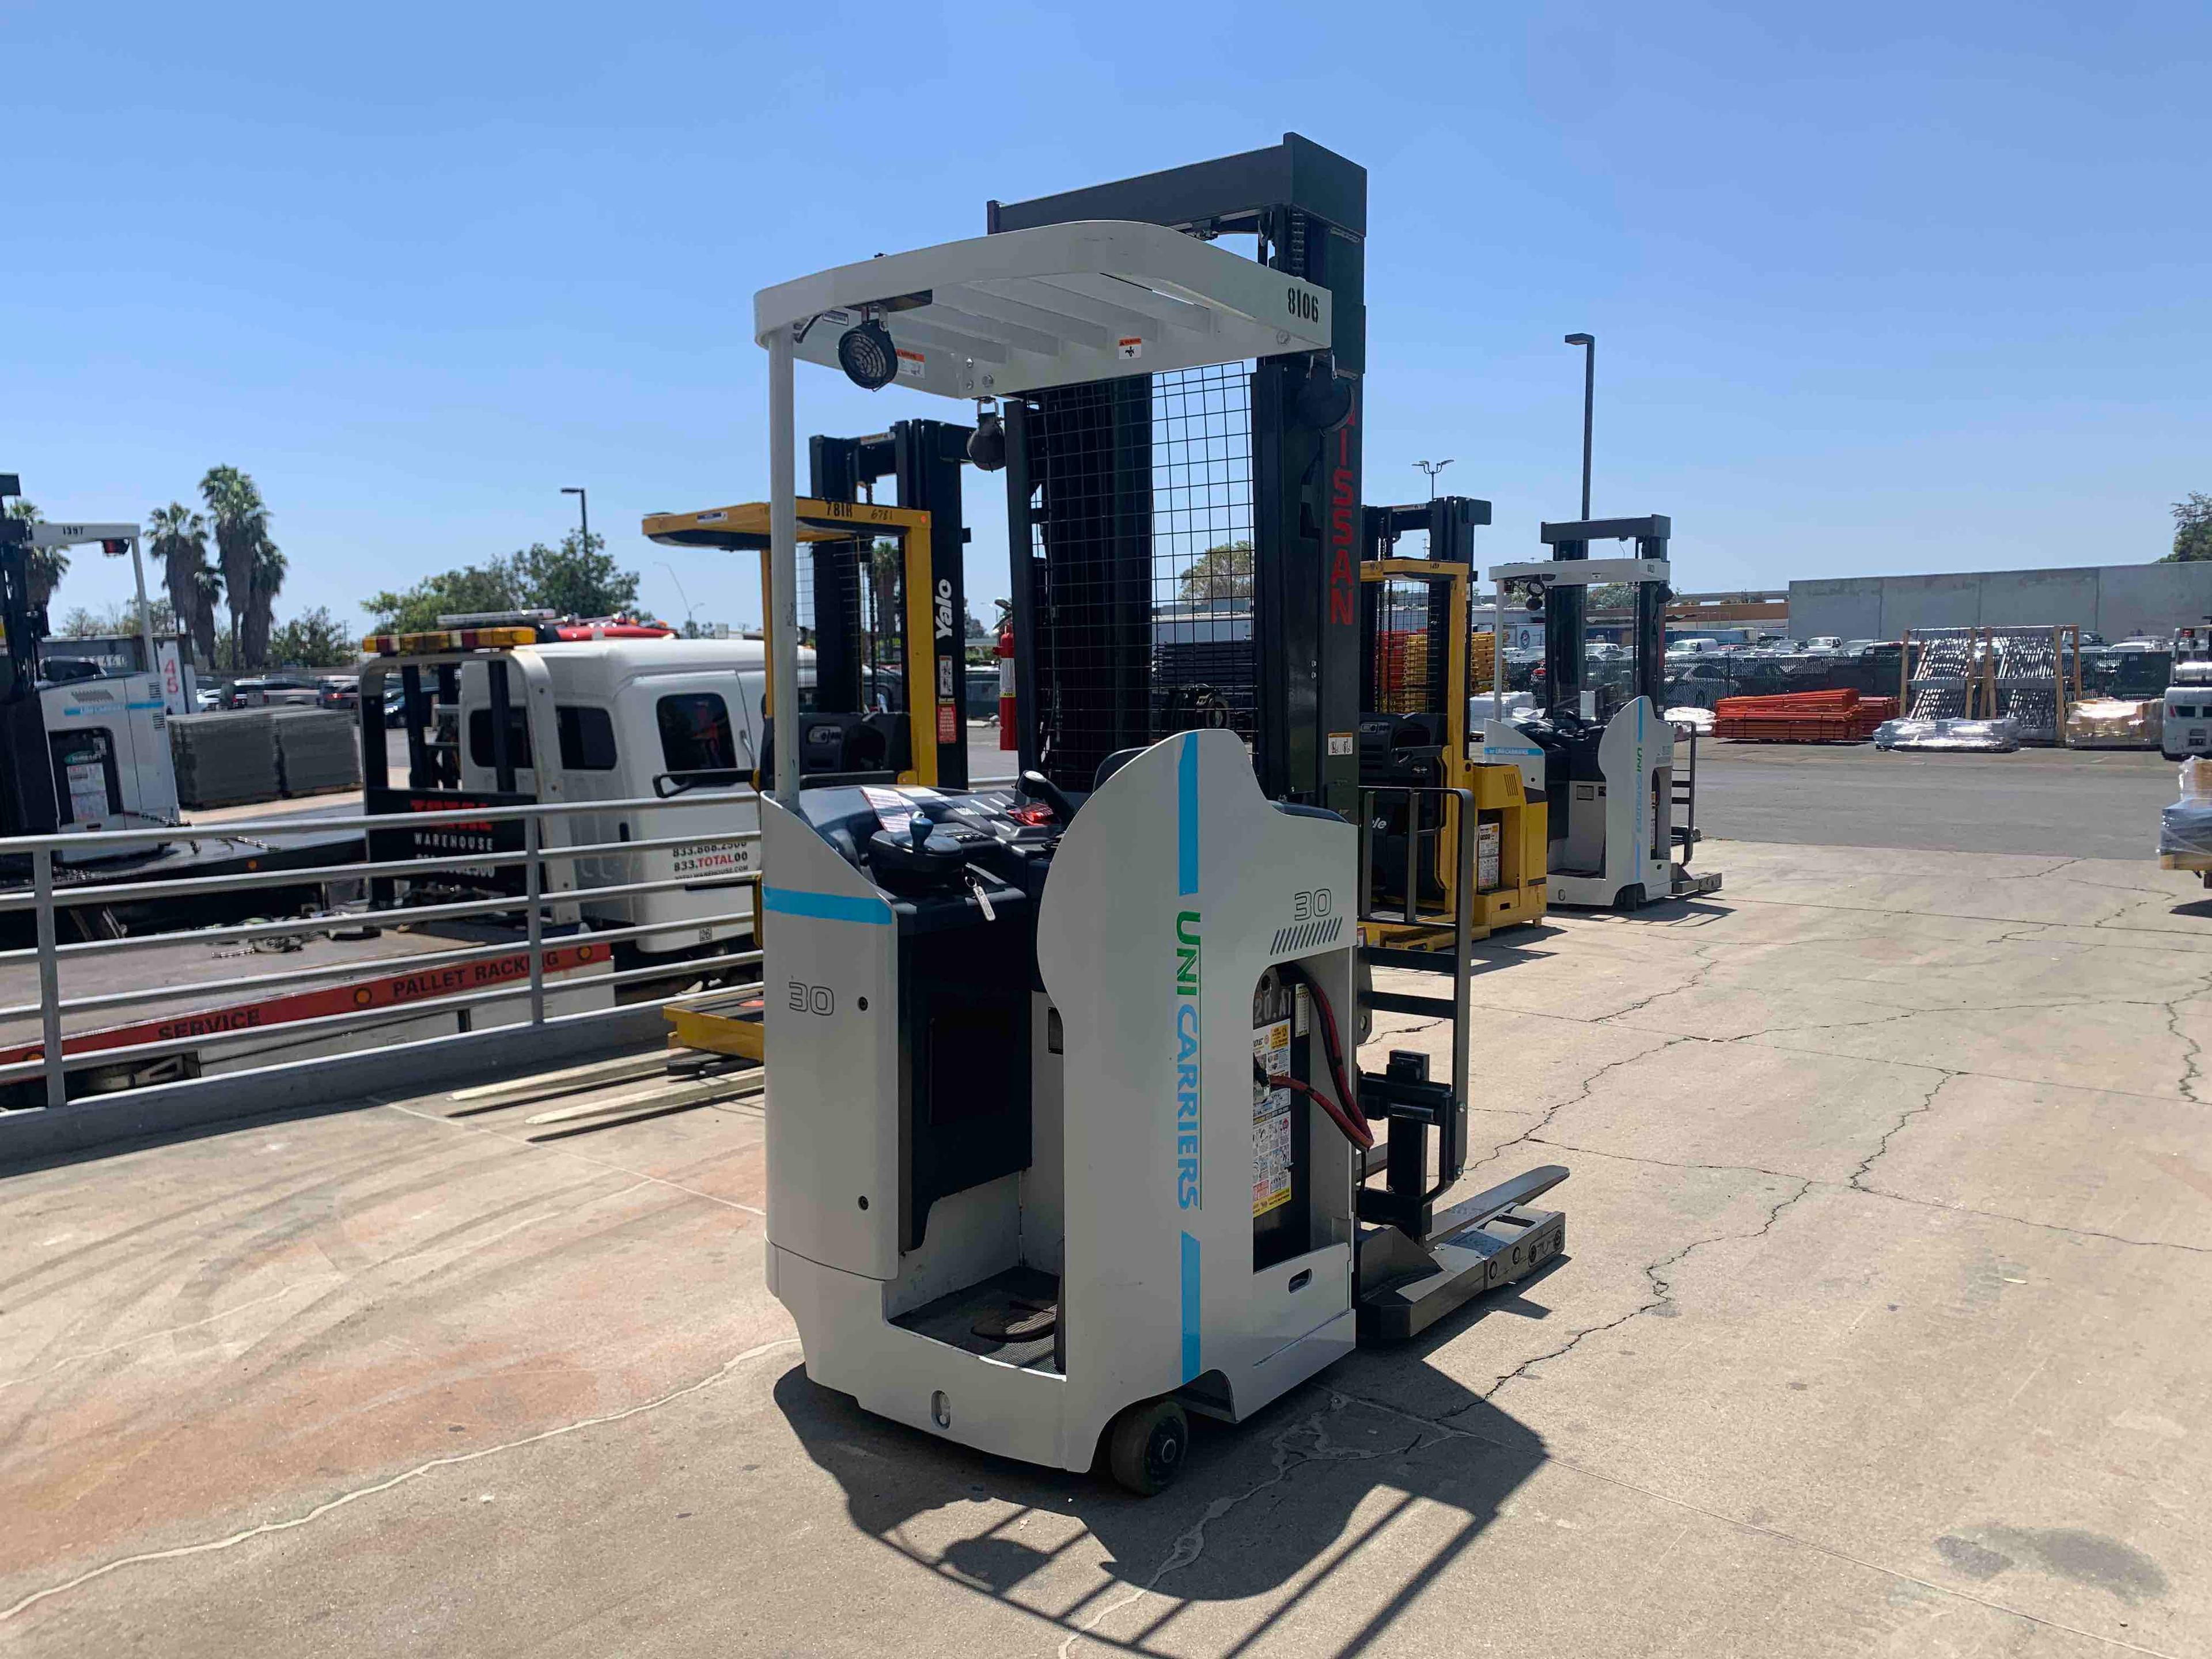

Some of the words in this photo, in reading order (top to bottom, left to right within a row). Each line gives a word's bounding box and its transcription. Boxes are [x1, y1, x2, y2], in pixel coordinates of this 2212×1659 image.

[1287, 287, 1319, 324] 8106
[1331, 400, 1355, 626] ISSAN
[414, 832, 494, 851] WAREHOUSE
[674, 851, 748, 872] 833.TOTAL00
[1294, 888, 1331, 921] 30
[393, 970, 465, 997] PALLET
[475, 952, 558, 980] RACKIG
[789, 982, 834, 1016] 30
[158, 1009, 261, 1039] SERVICE
[1176, 911, 1201, 1210] UNICARRIERS
